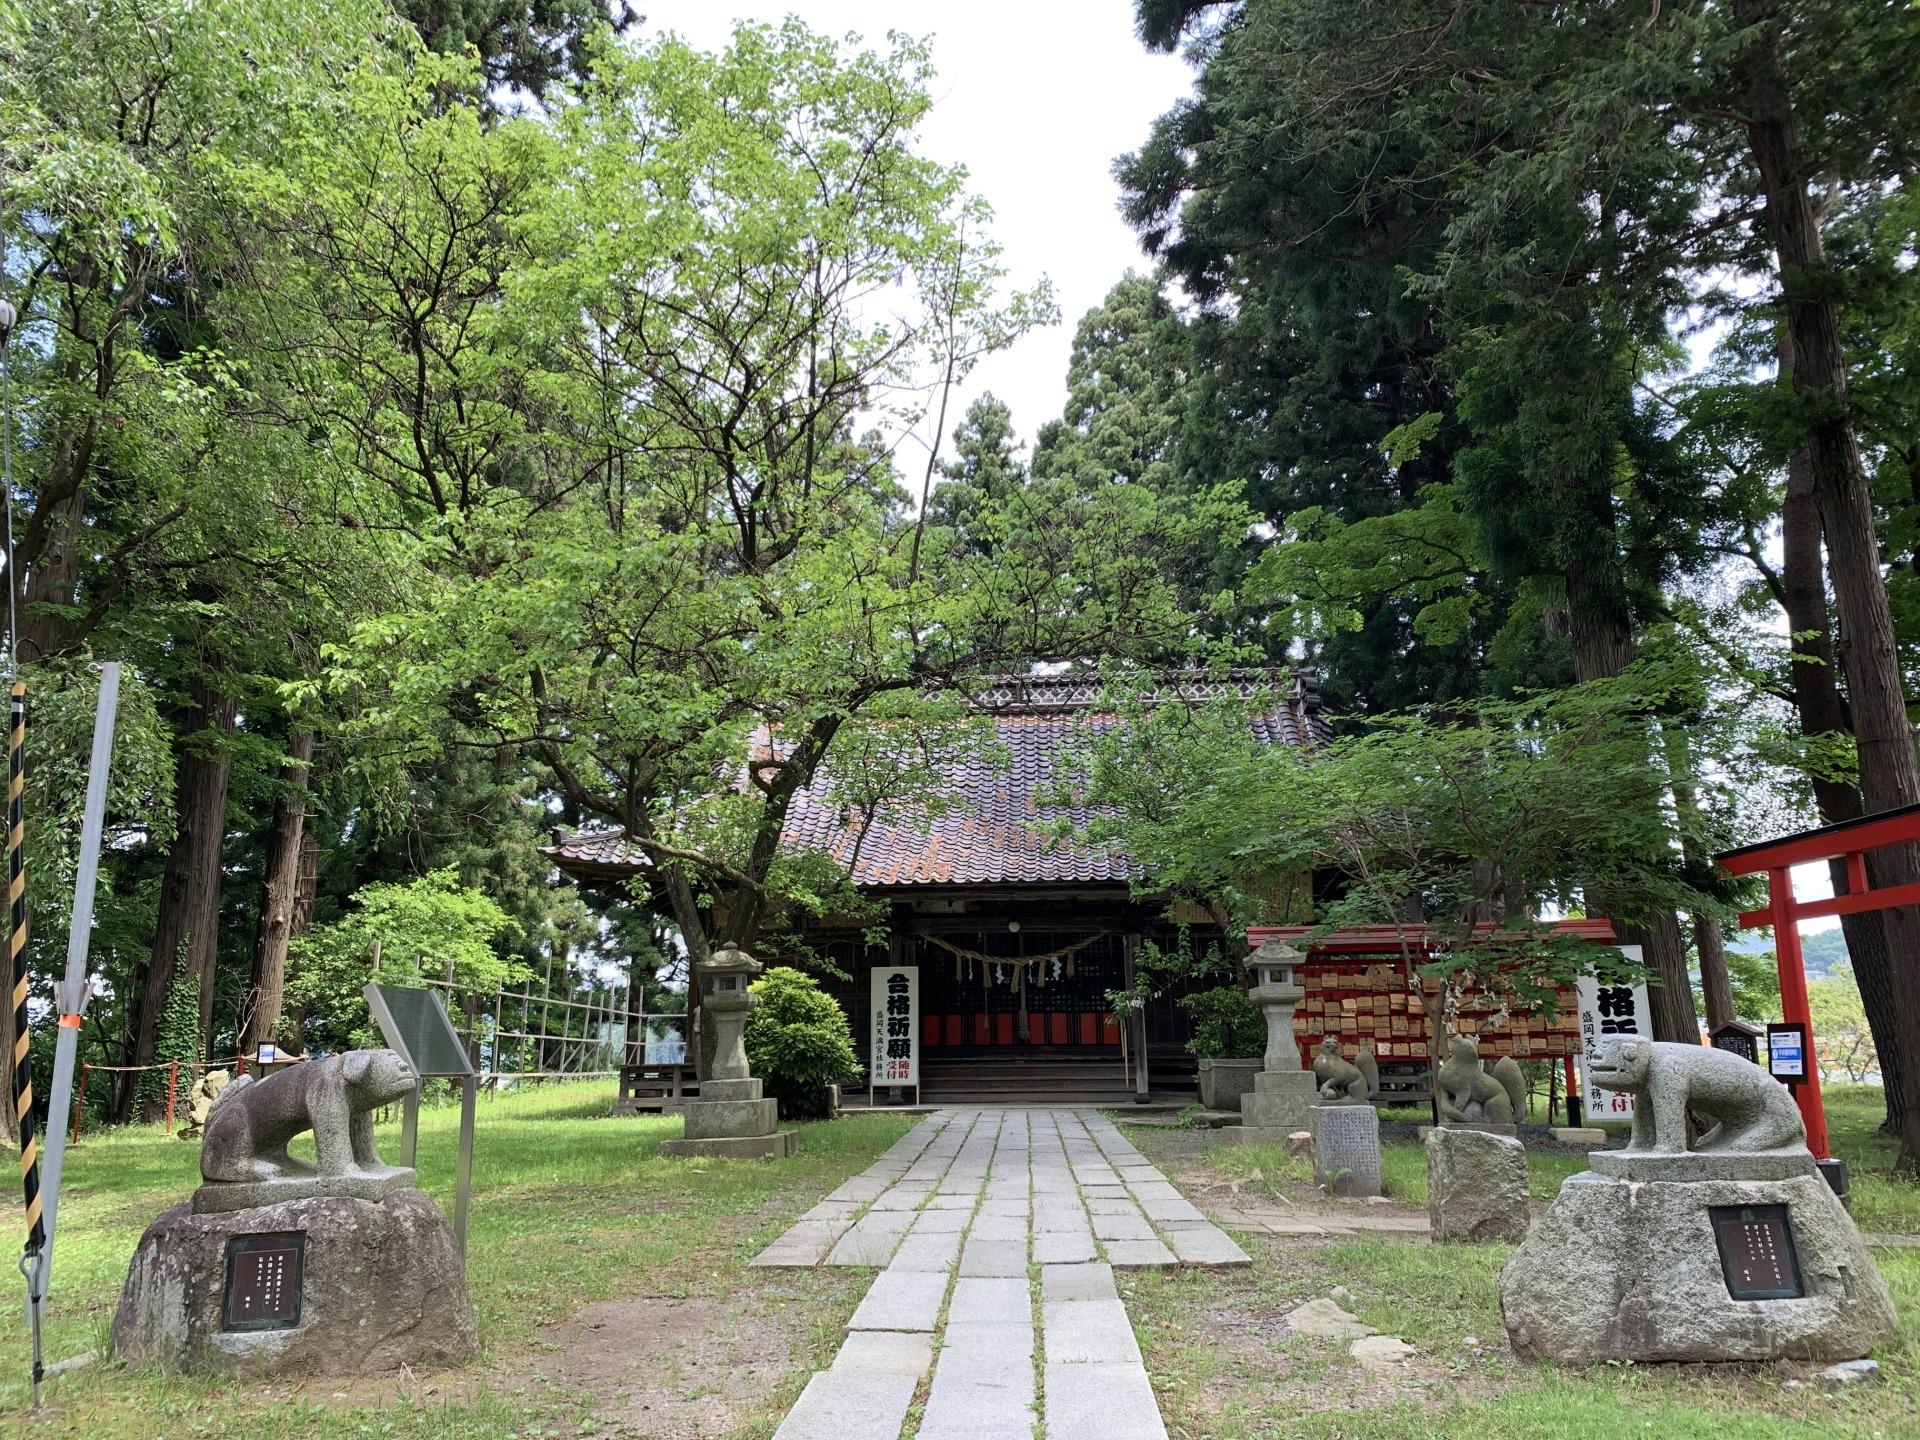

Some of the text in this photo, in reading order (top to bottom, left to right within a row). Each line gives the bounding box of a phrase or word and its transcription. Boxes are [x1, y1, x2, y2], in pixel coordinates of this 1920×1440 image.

[887, 973, 911, 1059] 合格祈願
[875, 1010, 884, 1080] 盛岡天満宮社務所
[886, 1060, 897, 1080] 受付
[898, 1060, 910, 1080] 随時
